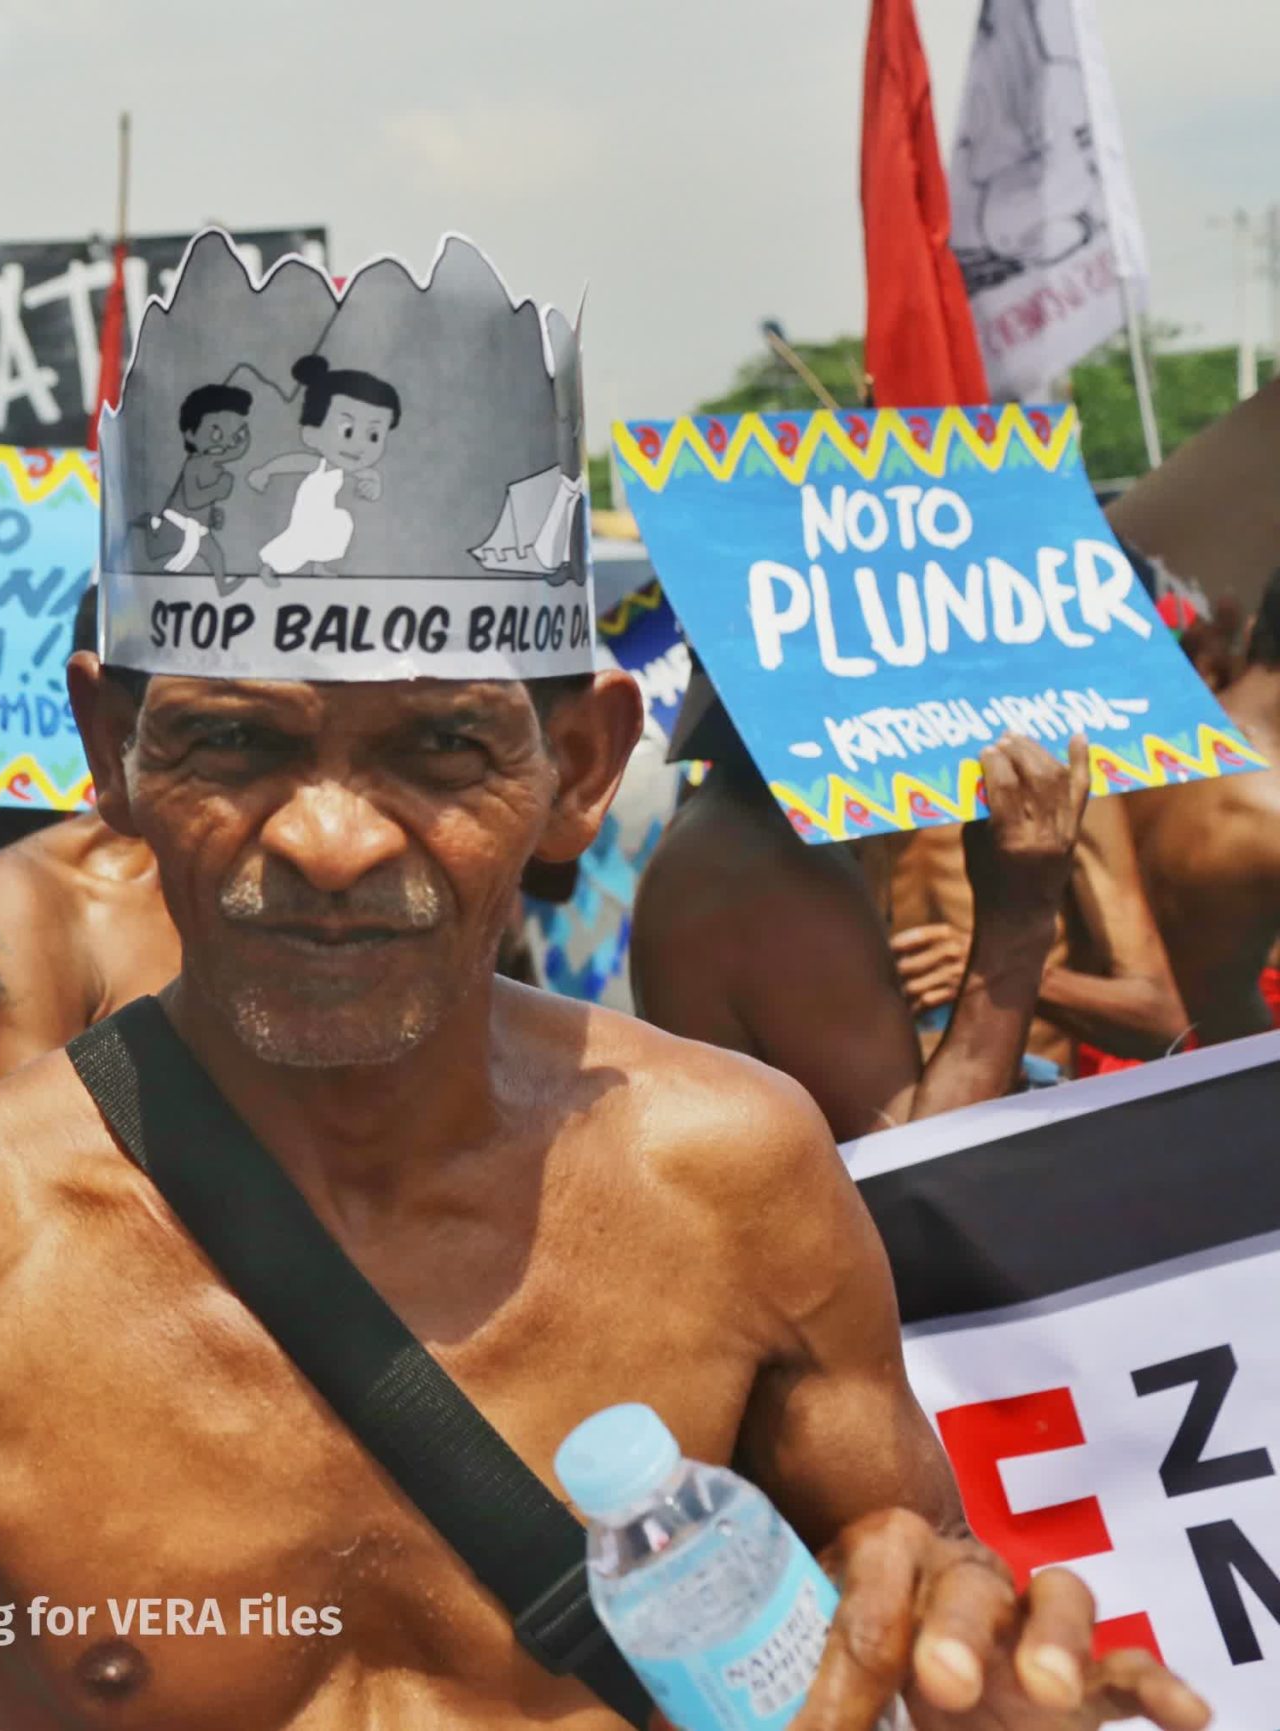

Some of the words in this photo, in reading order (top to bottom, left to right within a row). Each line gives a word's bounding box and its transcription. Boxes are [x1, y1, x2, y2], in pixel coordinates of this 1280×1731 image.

[150, 600, 256, 652] STOP
[275, 603, 450, 653] BALOG
[467, 604, 566, 653] BALOG
[747, 538, 1153, 678] PLUNDER
[1130, 1343, 1276, 1498] Z
